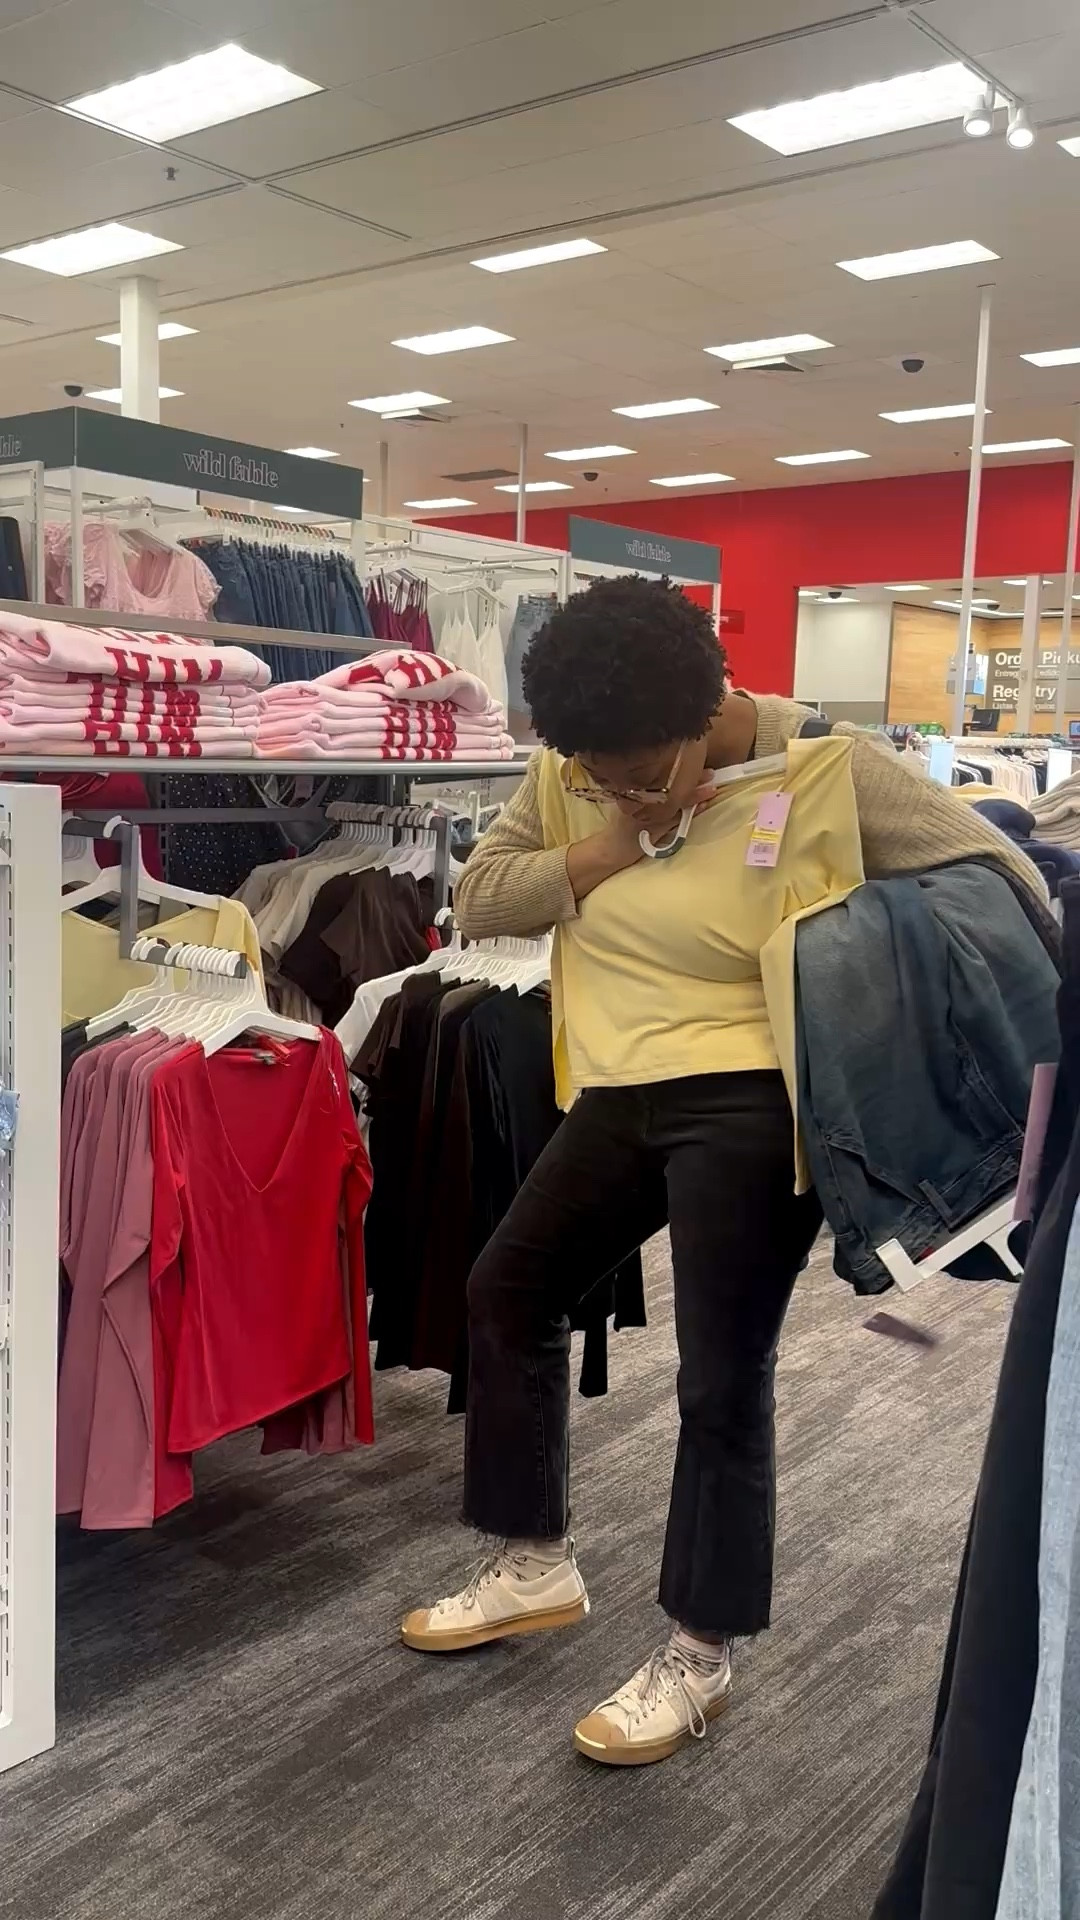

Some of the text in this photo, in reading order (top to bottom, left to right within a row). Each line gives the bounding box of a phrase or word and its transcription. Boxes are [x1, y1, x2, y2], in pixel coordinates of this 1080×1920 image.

[0, 434, 21, 458] ble
[183, 448, 279, 488] wild fable
[1042, 651, 1080, 665] Piku
[992, 684, 1057, 701] Regtry
